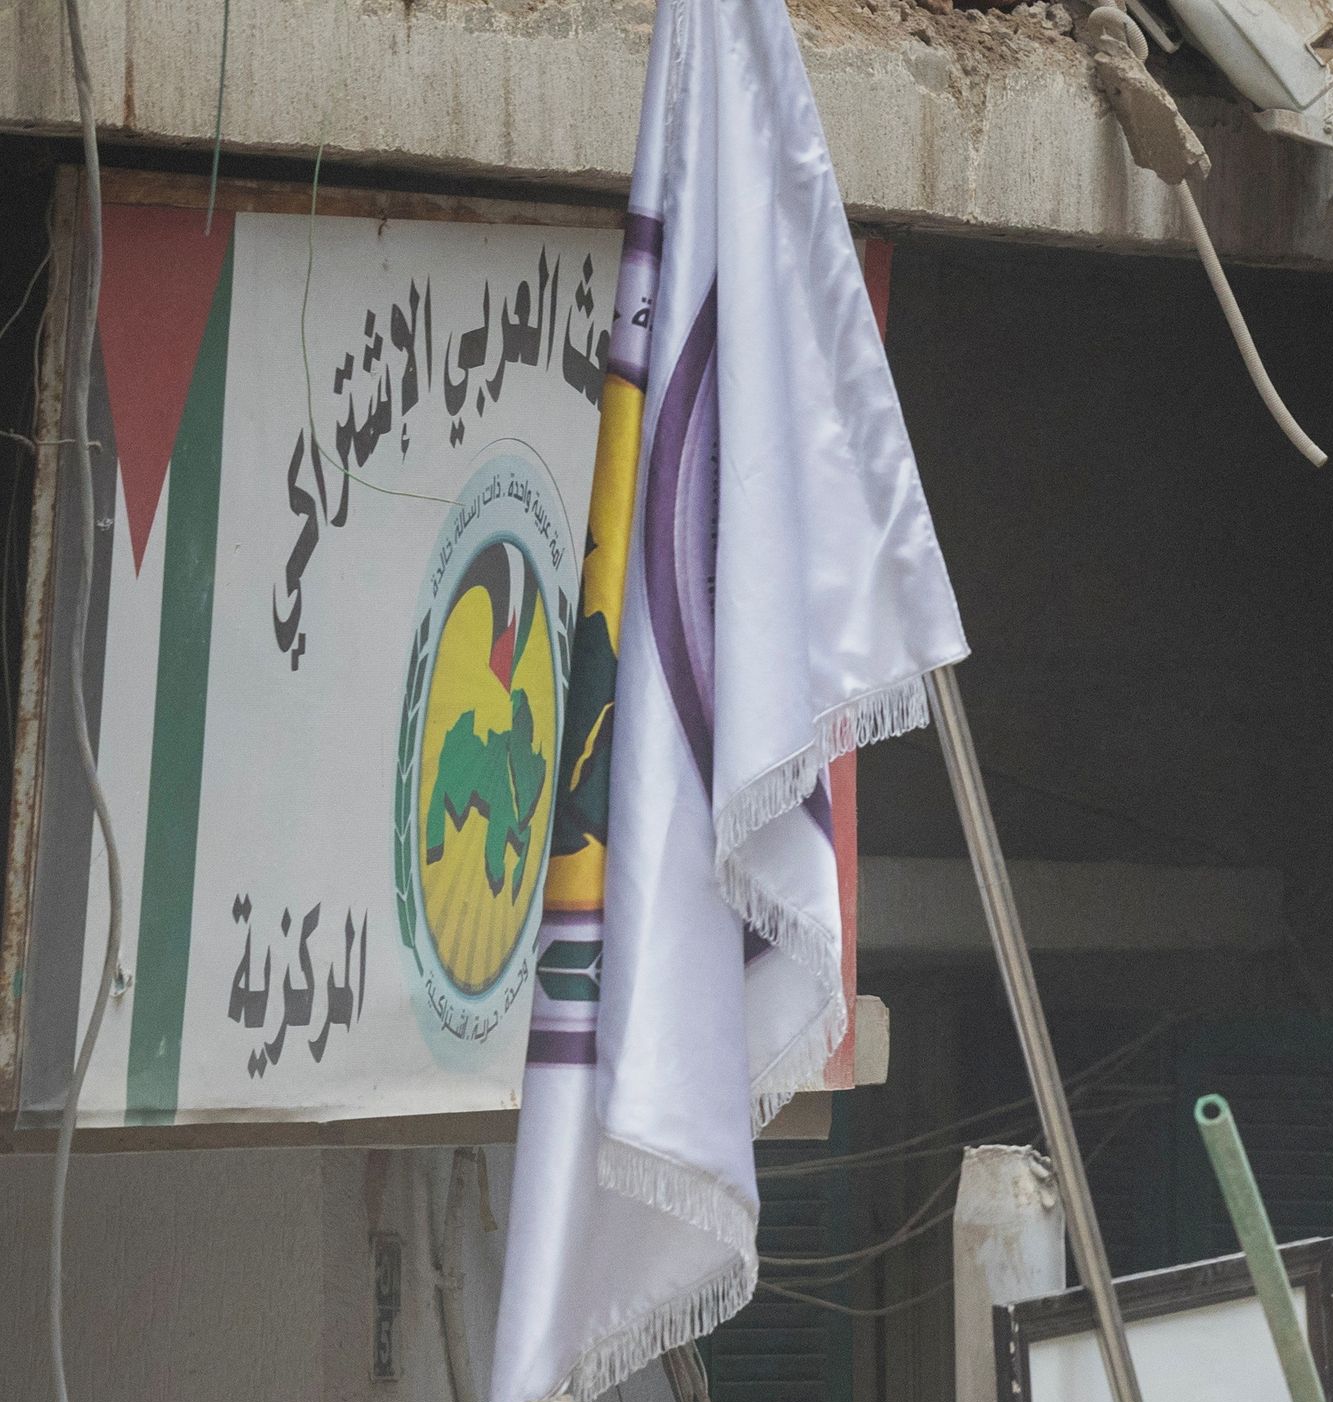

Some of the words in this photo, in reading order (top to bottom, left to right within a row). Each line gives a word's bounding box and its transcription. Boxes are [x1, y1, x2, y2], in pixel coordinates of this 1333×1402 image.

[444, 243, 561, 449] العربي
[506, 473, 533, 514] واحدة
[431, 537, 454, 599] خالدة
[228, 892, 368, 1080] المركزية
